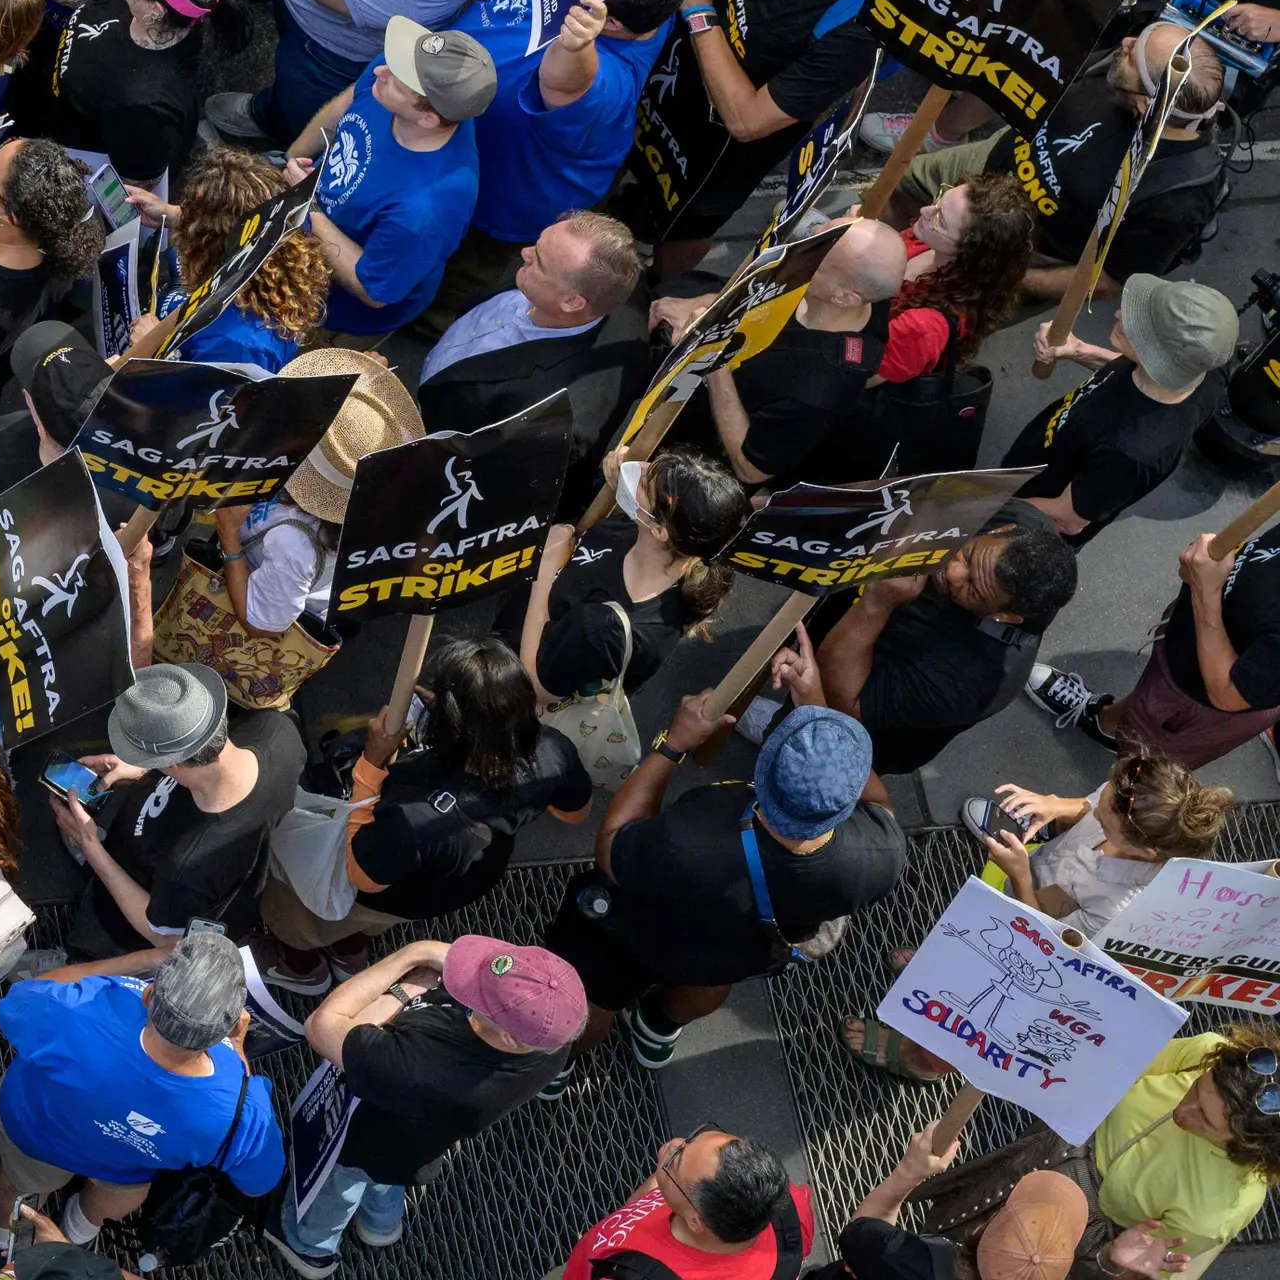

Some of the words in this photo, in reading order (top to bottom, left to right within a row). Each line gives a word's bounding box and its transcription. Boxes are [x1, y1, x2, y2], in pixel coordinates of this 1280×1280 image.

[945, 30, 986, 54] ON
[329, 142, 347, 191] UFT
[79, 451, 280, 500] STRIKE!
[162, 469, 204, 482] ON
[337, 545, 537, 611] STRIKE!
[422, 558, 464, 575] ON
[729, 549, 948, 587] STRIKE!
[828, 556, 872, 570] ON
[1, 598, 22, 641] ON
[1101, 937, 1224, 968] WRITERS
[1182, 966, 1210, 978] ON
[901, 989, 1068, 1091] SOLIDARITY
[1048, 1008, 1107, 1048] WGA
